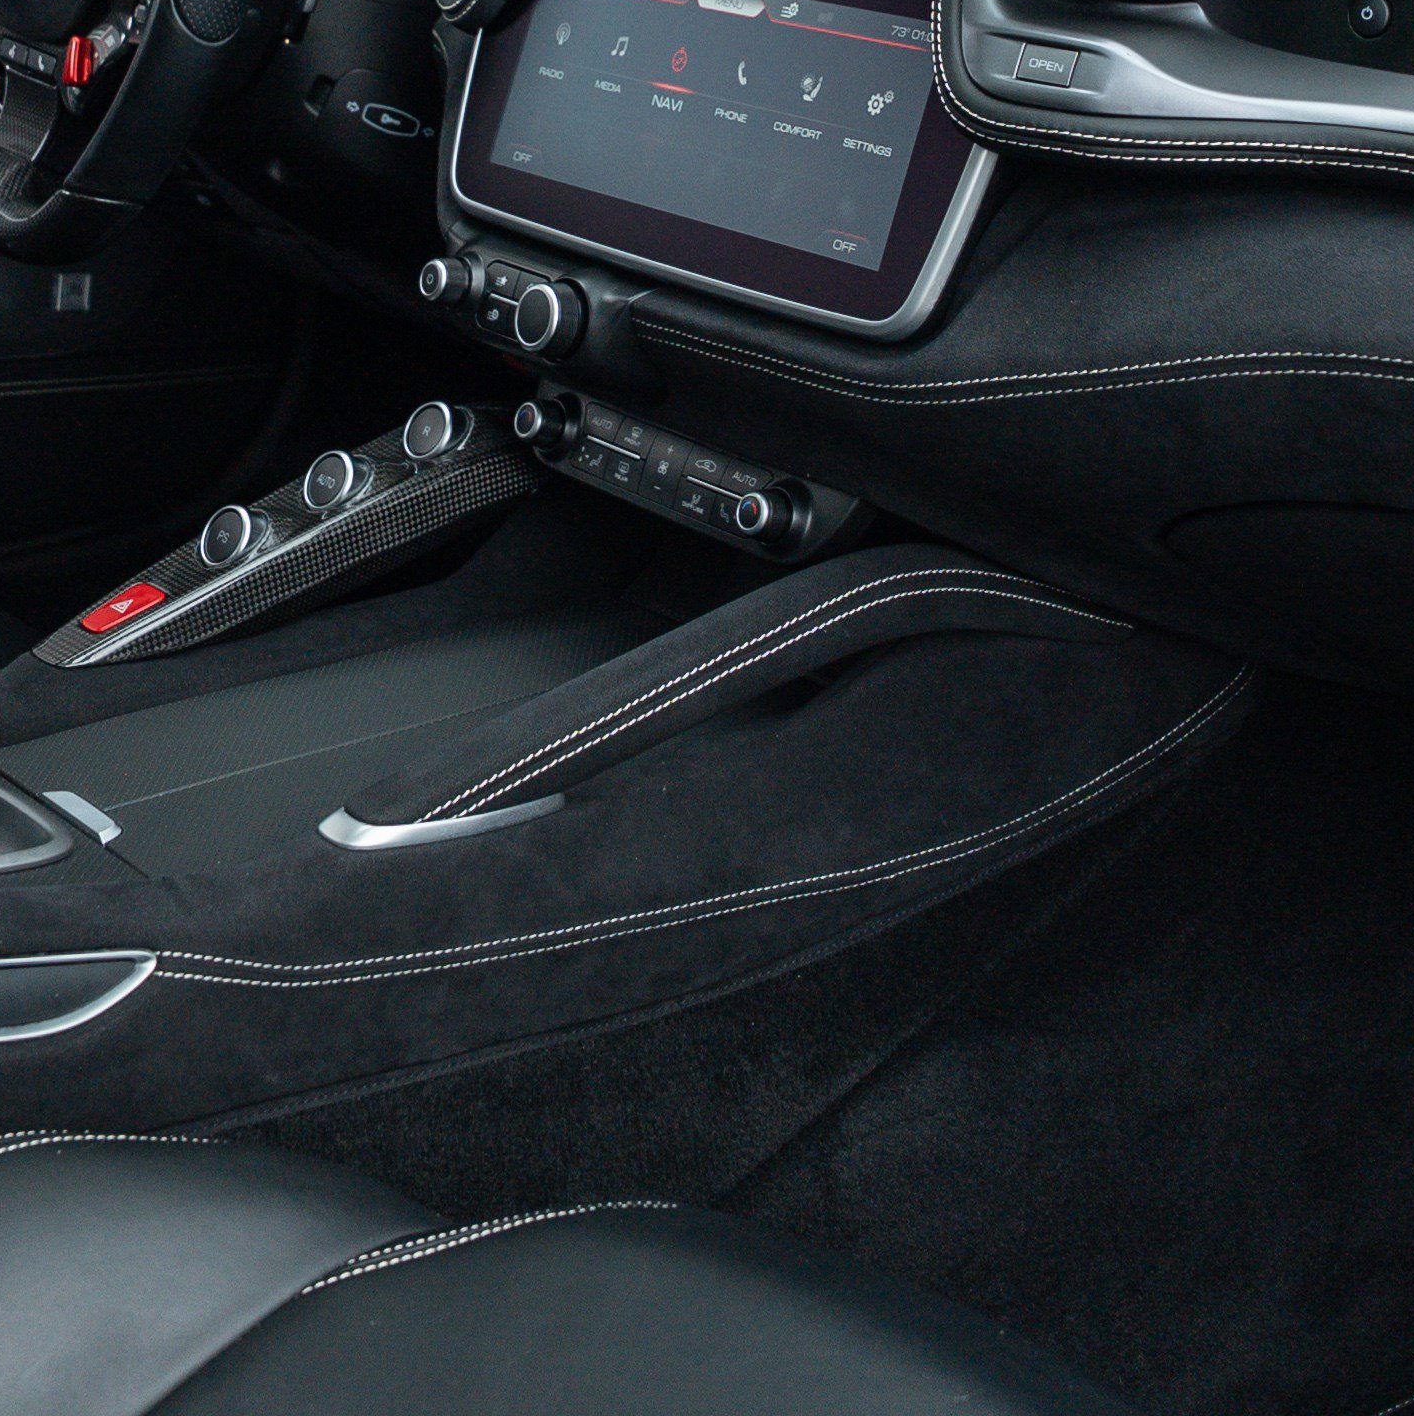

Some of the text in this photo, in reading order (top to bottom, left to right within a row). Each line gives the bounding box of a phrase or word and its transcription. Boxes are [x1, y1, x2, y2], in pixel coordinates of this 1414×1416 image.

[1028, 57, 1064, 73] OPEN
[538, 65, 565, 82] RADIO
[594, 79, 622, 95] MEDIA
[651, 94, 684, 113] NAVI
[714, 106, 749, 125] PHONE
[773, 120, 823, 142] COMFORT
[842, 137, 893, 158] SETTINGS
[512, 150, 533, 165] OFF
[832, 237, 858, 254] OFF
[423, 425, 431, 436] R
[591, 415, 613, 431] AUTO
[317, 472, 335, 488] AUTO
[731, 470, 757, 487] AUTO
[217, 530, 230, 544] PS
